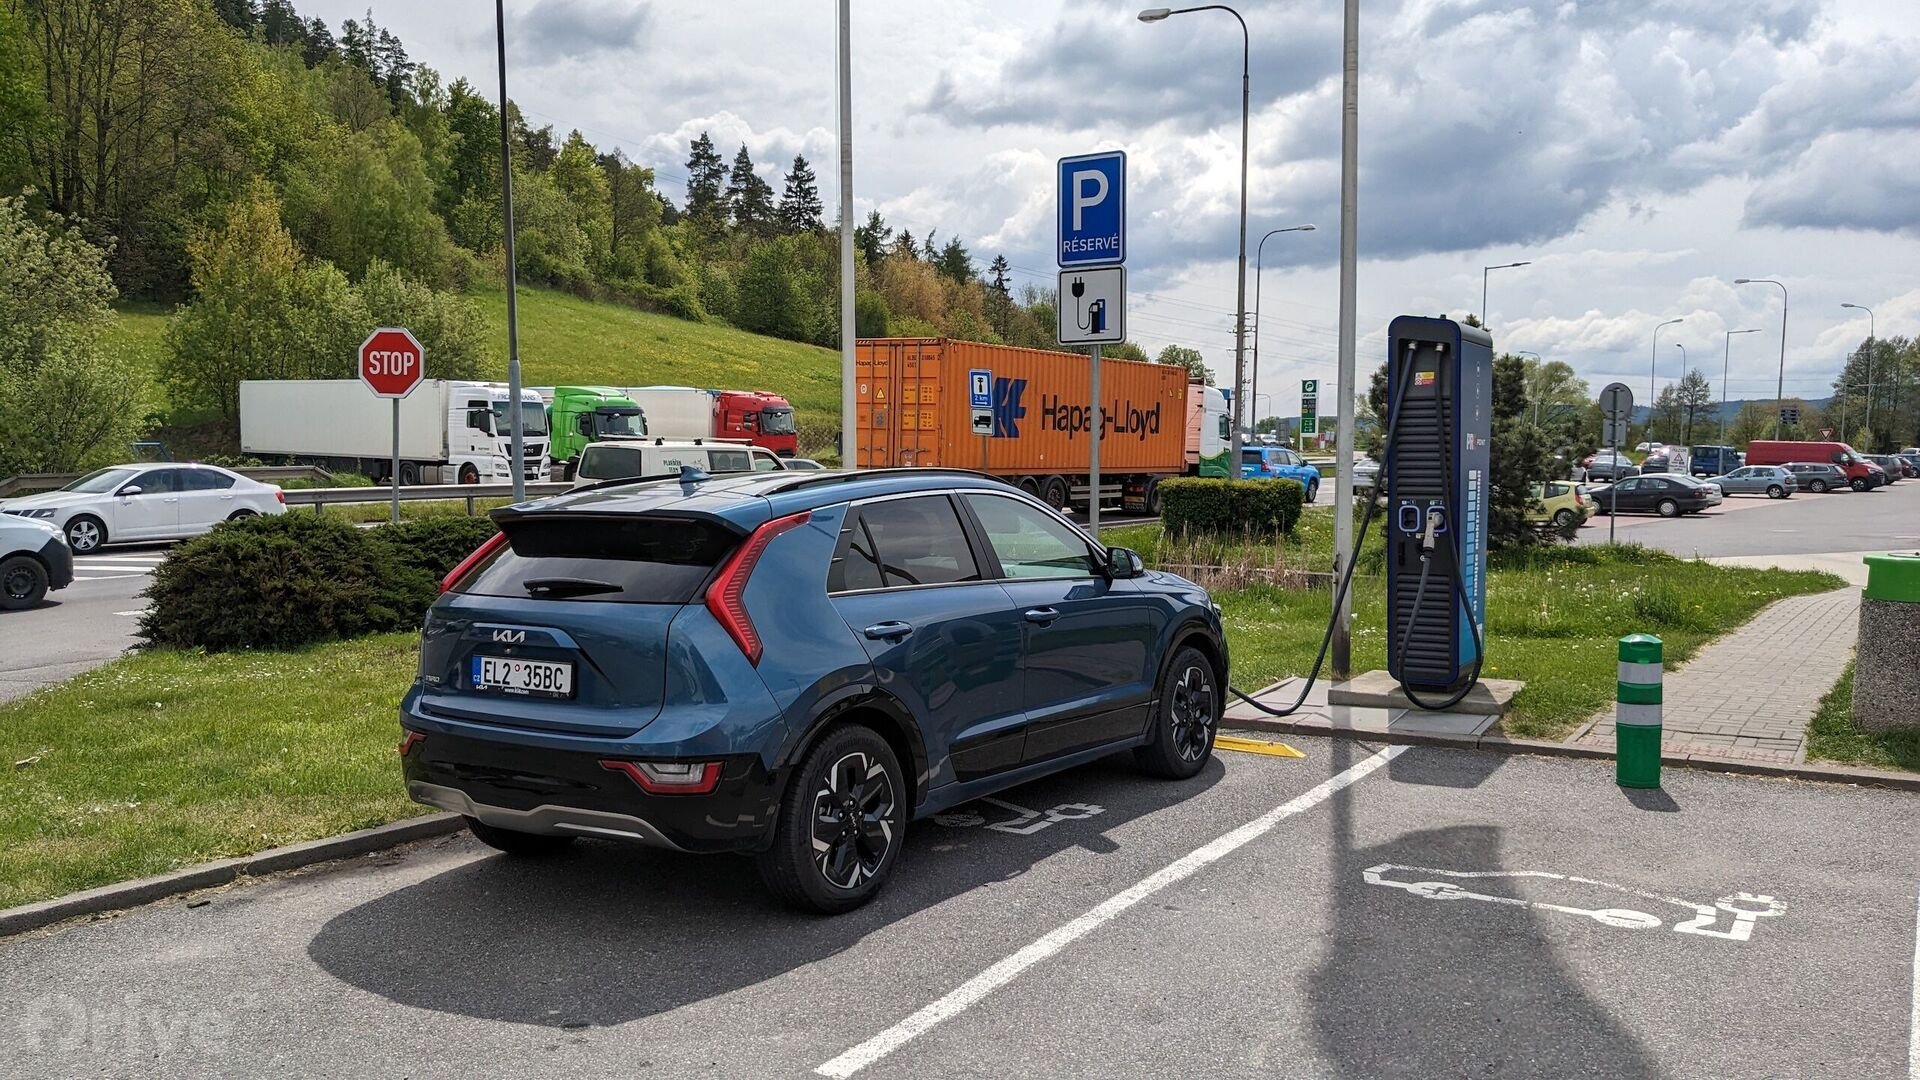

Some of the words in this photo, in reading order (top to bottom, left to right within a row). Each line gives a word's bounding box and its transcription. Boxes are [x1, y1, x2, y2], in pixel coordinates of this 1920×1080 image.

[1073, 169, 1109, 231] P
[1063, 233, 1119, 253] RÉSERVÉ
[369, 351, 415, 376] STOP
[473, 674, 481, 682] CZ
[484, 660, 511, 685] EL2
[523, 664, 564, 691] 35BC
